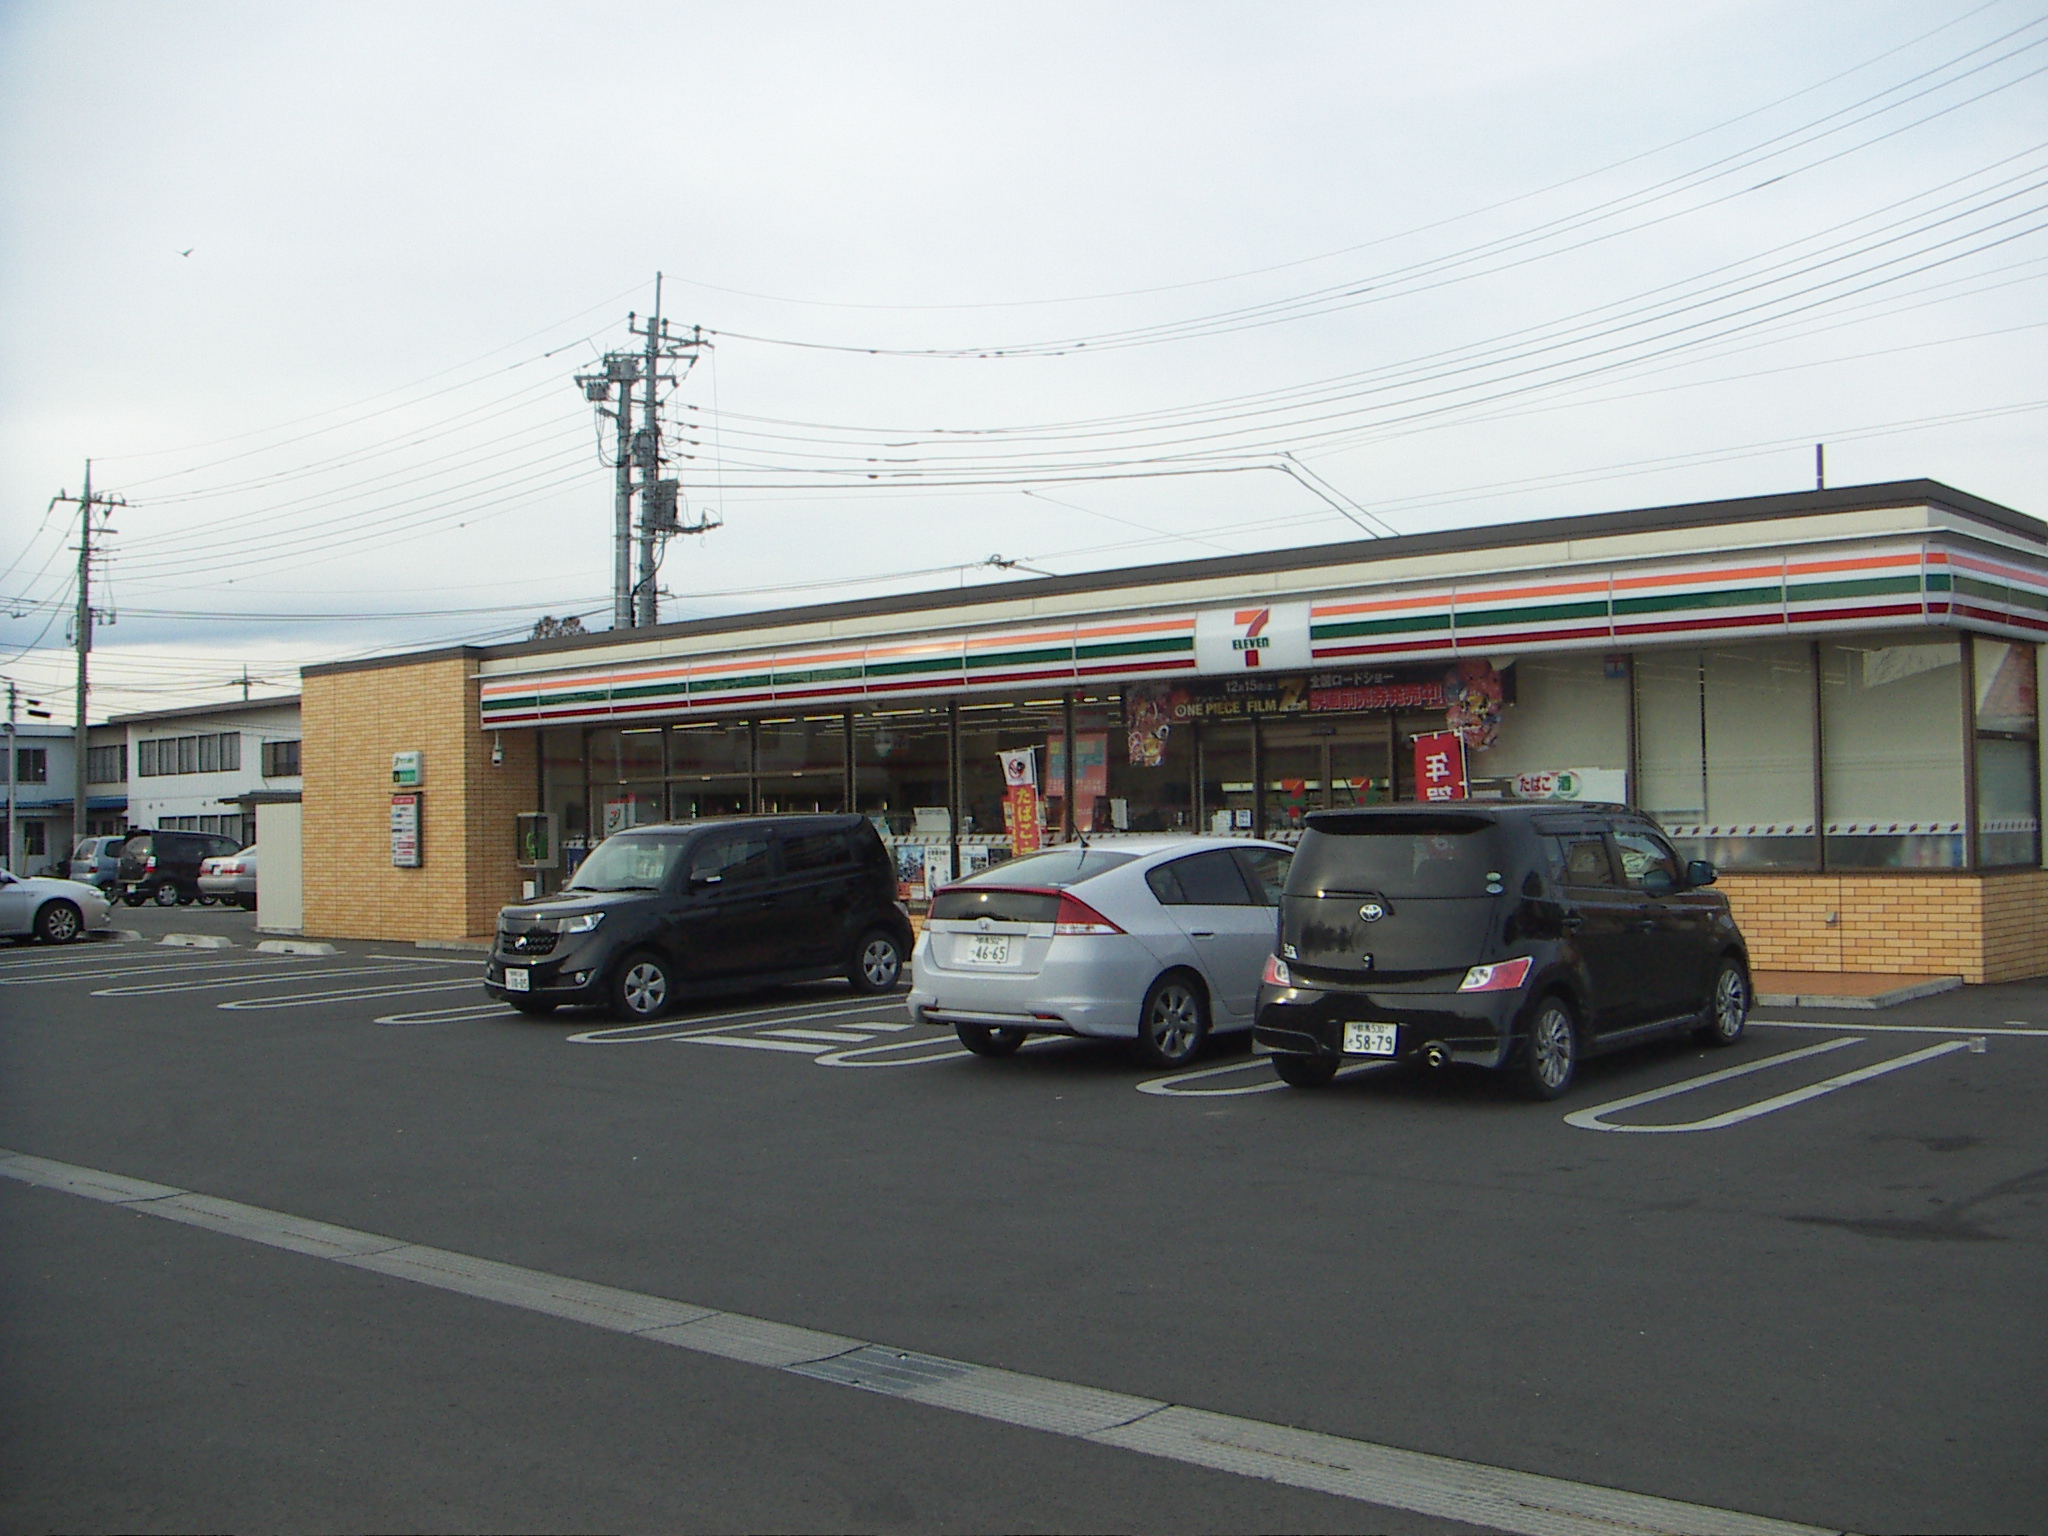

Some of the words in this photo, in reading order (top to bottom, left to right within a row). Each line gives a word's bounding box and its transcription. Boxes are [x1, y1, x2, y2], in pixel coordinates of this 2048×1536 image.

[1234, 608, 1269, 667] 7
[1174, 703, 1203, 718] ONE
[1206, 701, 1241, 715] PIECE
[1247, 699, 1277, 713] FILM
[1520, 777, 1552, 792] たばこ
[1557, 775, 1572, 791] 酒
[976, 945, 1006, 960] 46-65
[1355, 1034, 1392, 1051] 58-79
